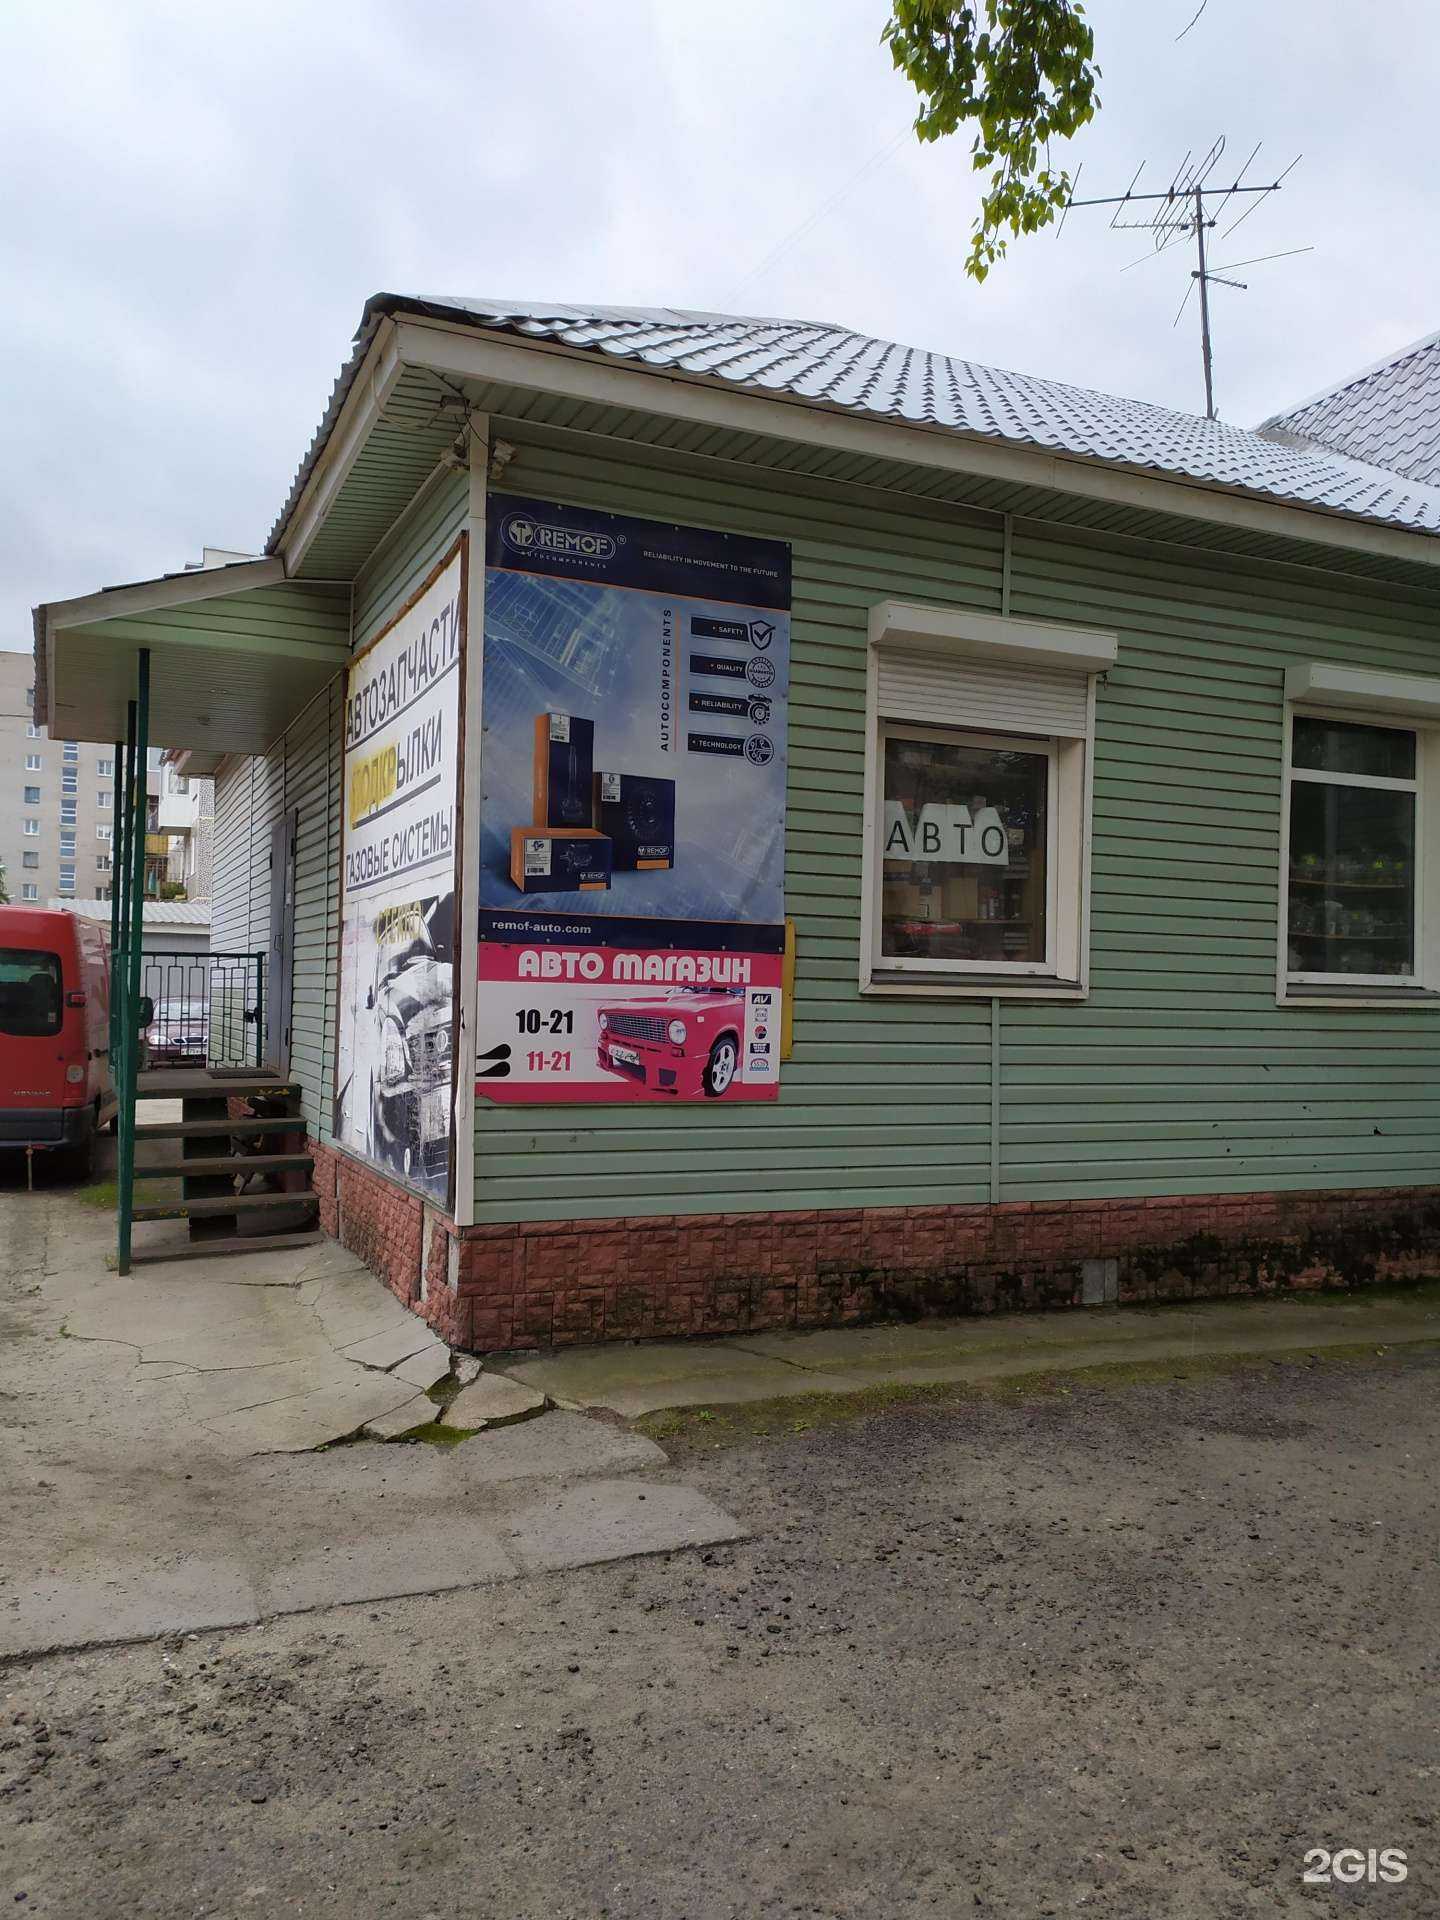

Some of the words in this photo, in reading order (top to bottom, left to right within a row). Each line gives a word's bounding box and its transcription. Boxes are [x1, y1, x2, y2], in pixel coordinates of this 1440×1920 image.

[540, 529, 608, 554] REMOF
[643, 550, 683, 562] RELIABILITY
[693, 559, 728, 570] MOVEMENT
[740, 566, 752, 574] THE
[753, 568, 778, 578] FUTURE
[718, 626, 744, 636] SAFETY
[660, 608, 672, 752] AUTOCOMPONENTS
[716, 663, 743, 673] QUALITY
[701, 699, 742, 710] RELIABILITY
[699, 739, 742, 750] TECHNOLOGY
[391, 805, 453, 869] СИСТЕМЫ
[885, 820, 1004, 858] АВТО
[492, 920, 592, 935] remof-auto.com
[518, 950, 604, 979] АВТО
[612, 953, 751, 983] МАГАЗИН
[515, 1009, 574, 1034] 10-21
[526, 1050, 571, 1072] 11-21
